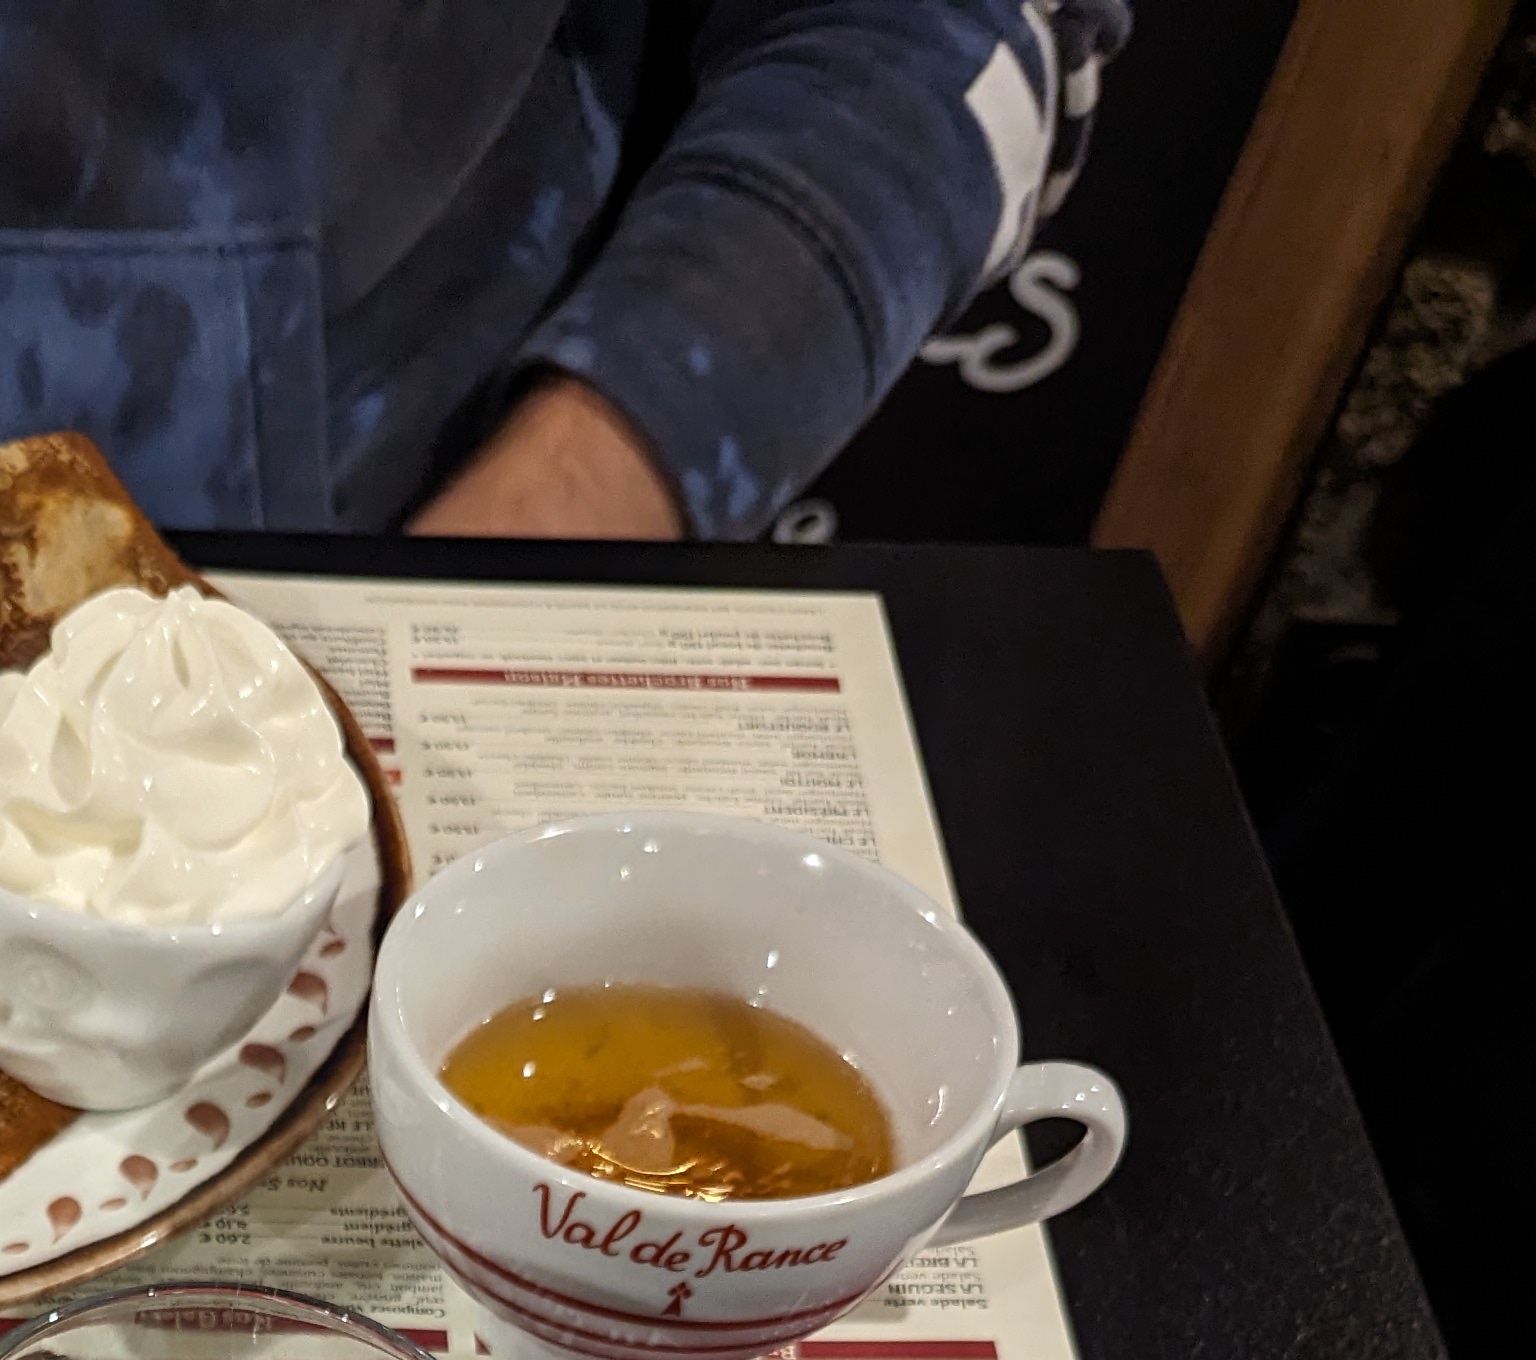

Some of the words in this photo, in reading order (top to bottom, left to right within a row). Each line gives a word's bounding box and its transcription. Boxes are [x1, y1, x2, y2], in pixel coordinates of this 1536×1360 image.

[532, 1183, 642, 1256] Val
[629, 1230, 691, 1272] de
[694, 1223, 849, 1279] Rance
